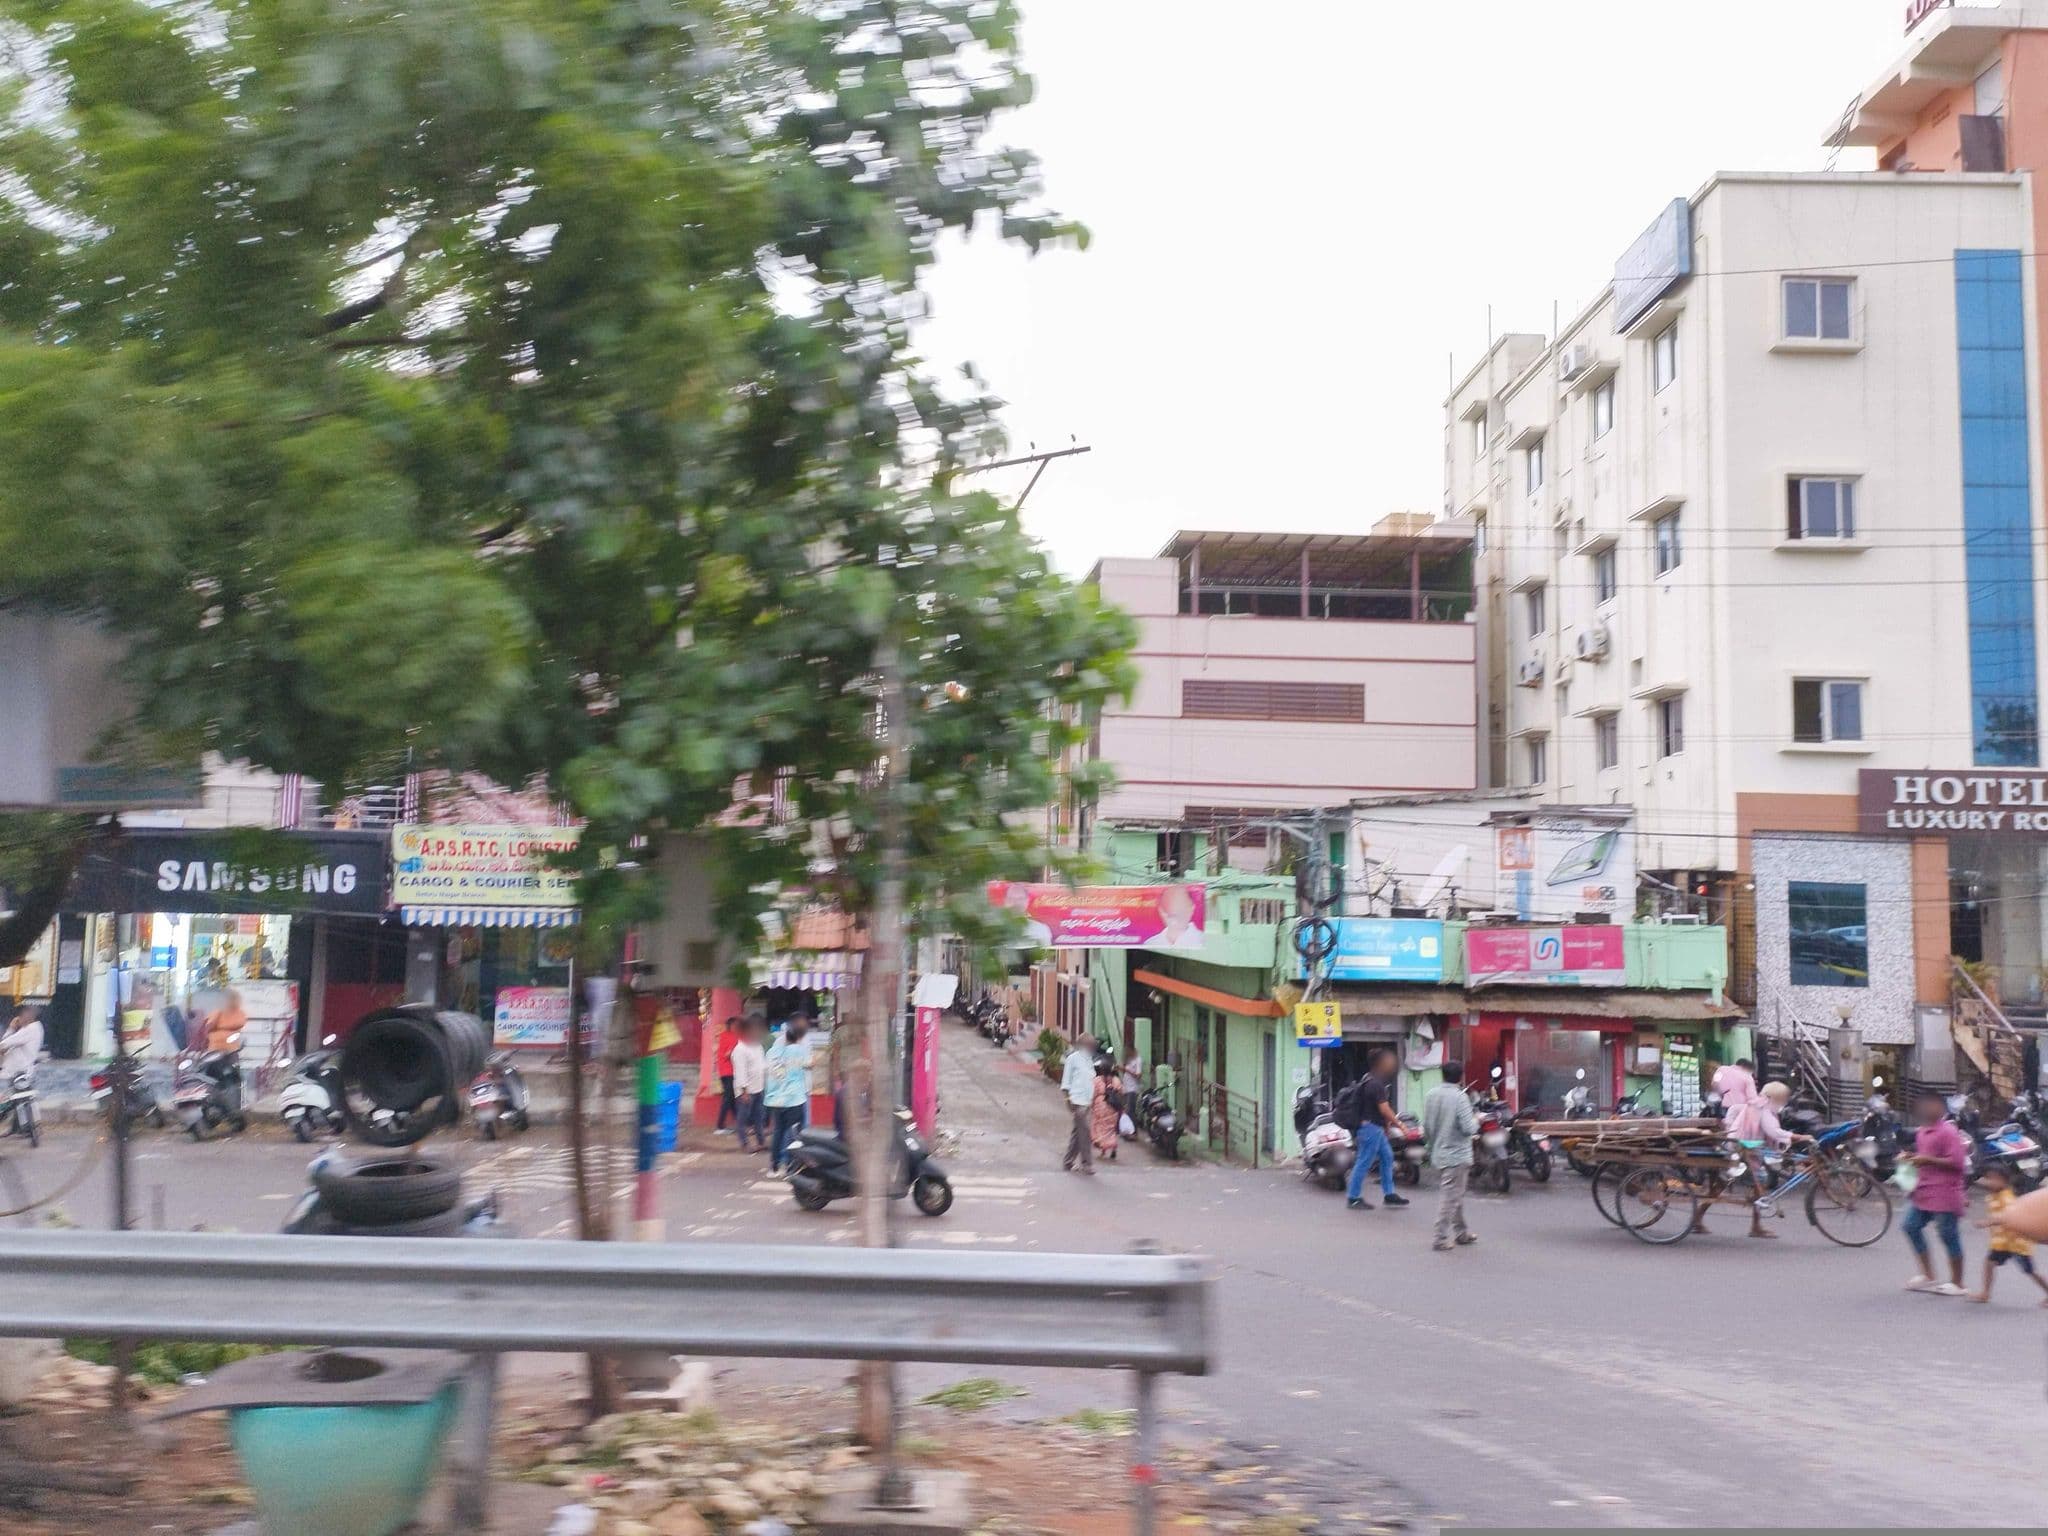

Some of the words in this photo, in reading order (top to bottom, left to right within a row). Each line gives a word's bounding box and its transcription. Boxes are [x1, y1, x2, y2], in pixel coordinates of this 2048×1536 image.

[1893, 775, 2048, 806] HOTEL
[1887, 808, 2006, 830] LUXURY
[400, 876, 453, 887] CARGO
